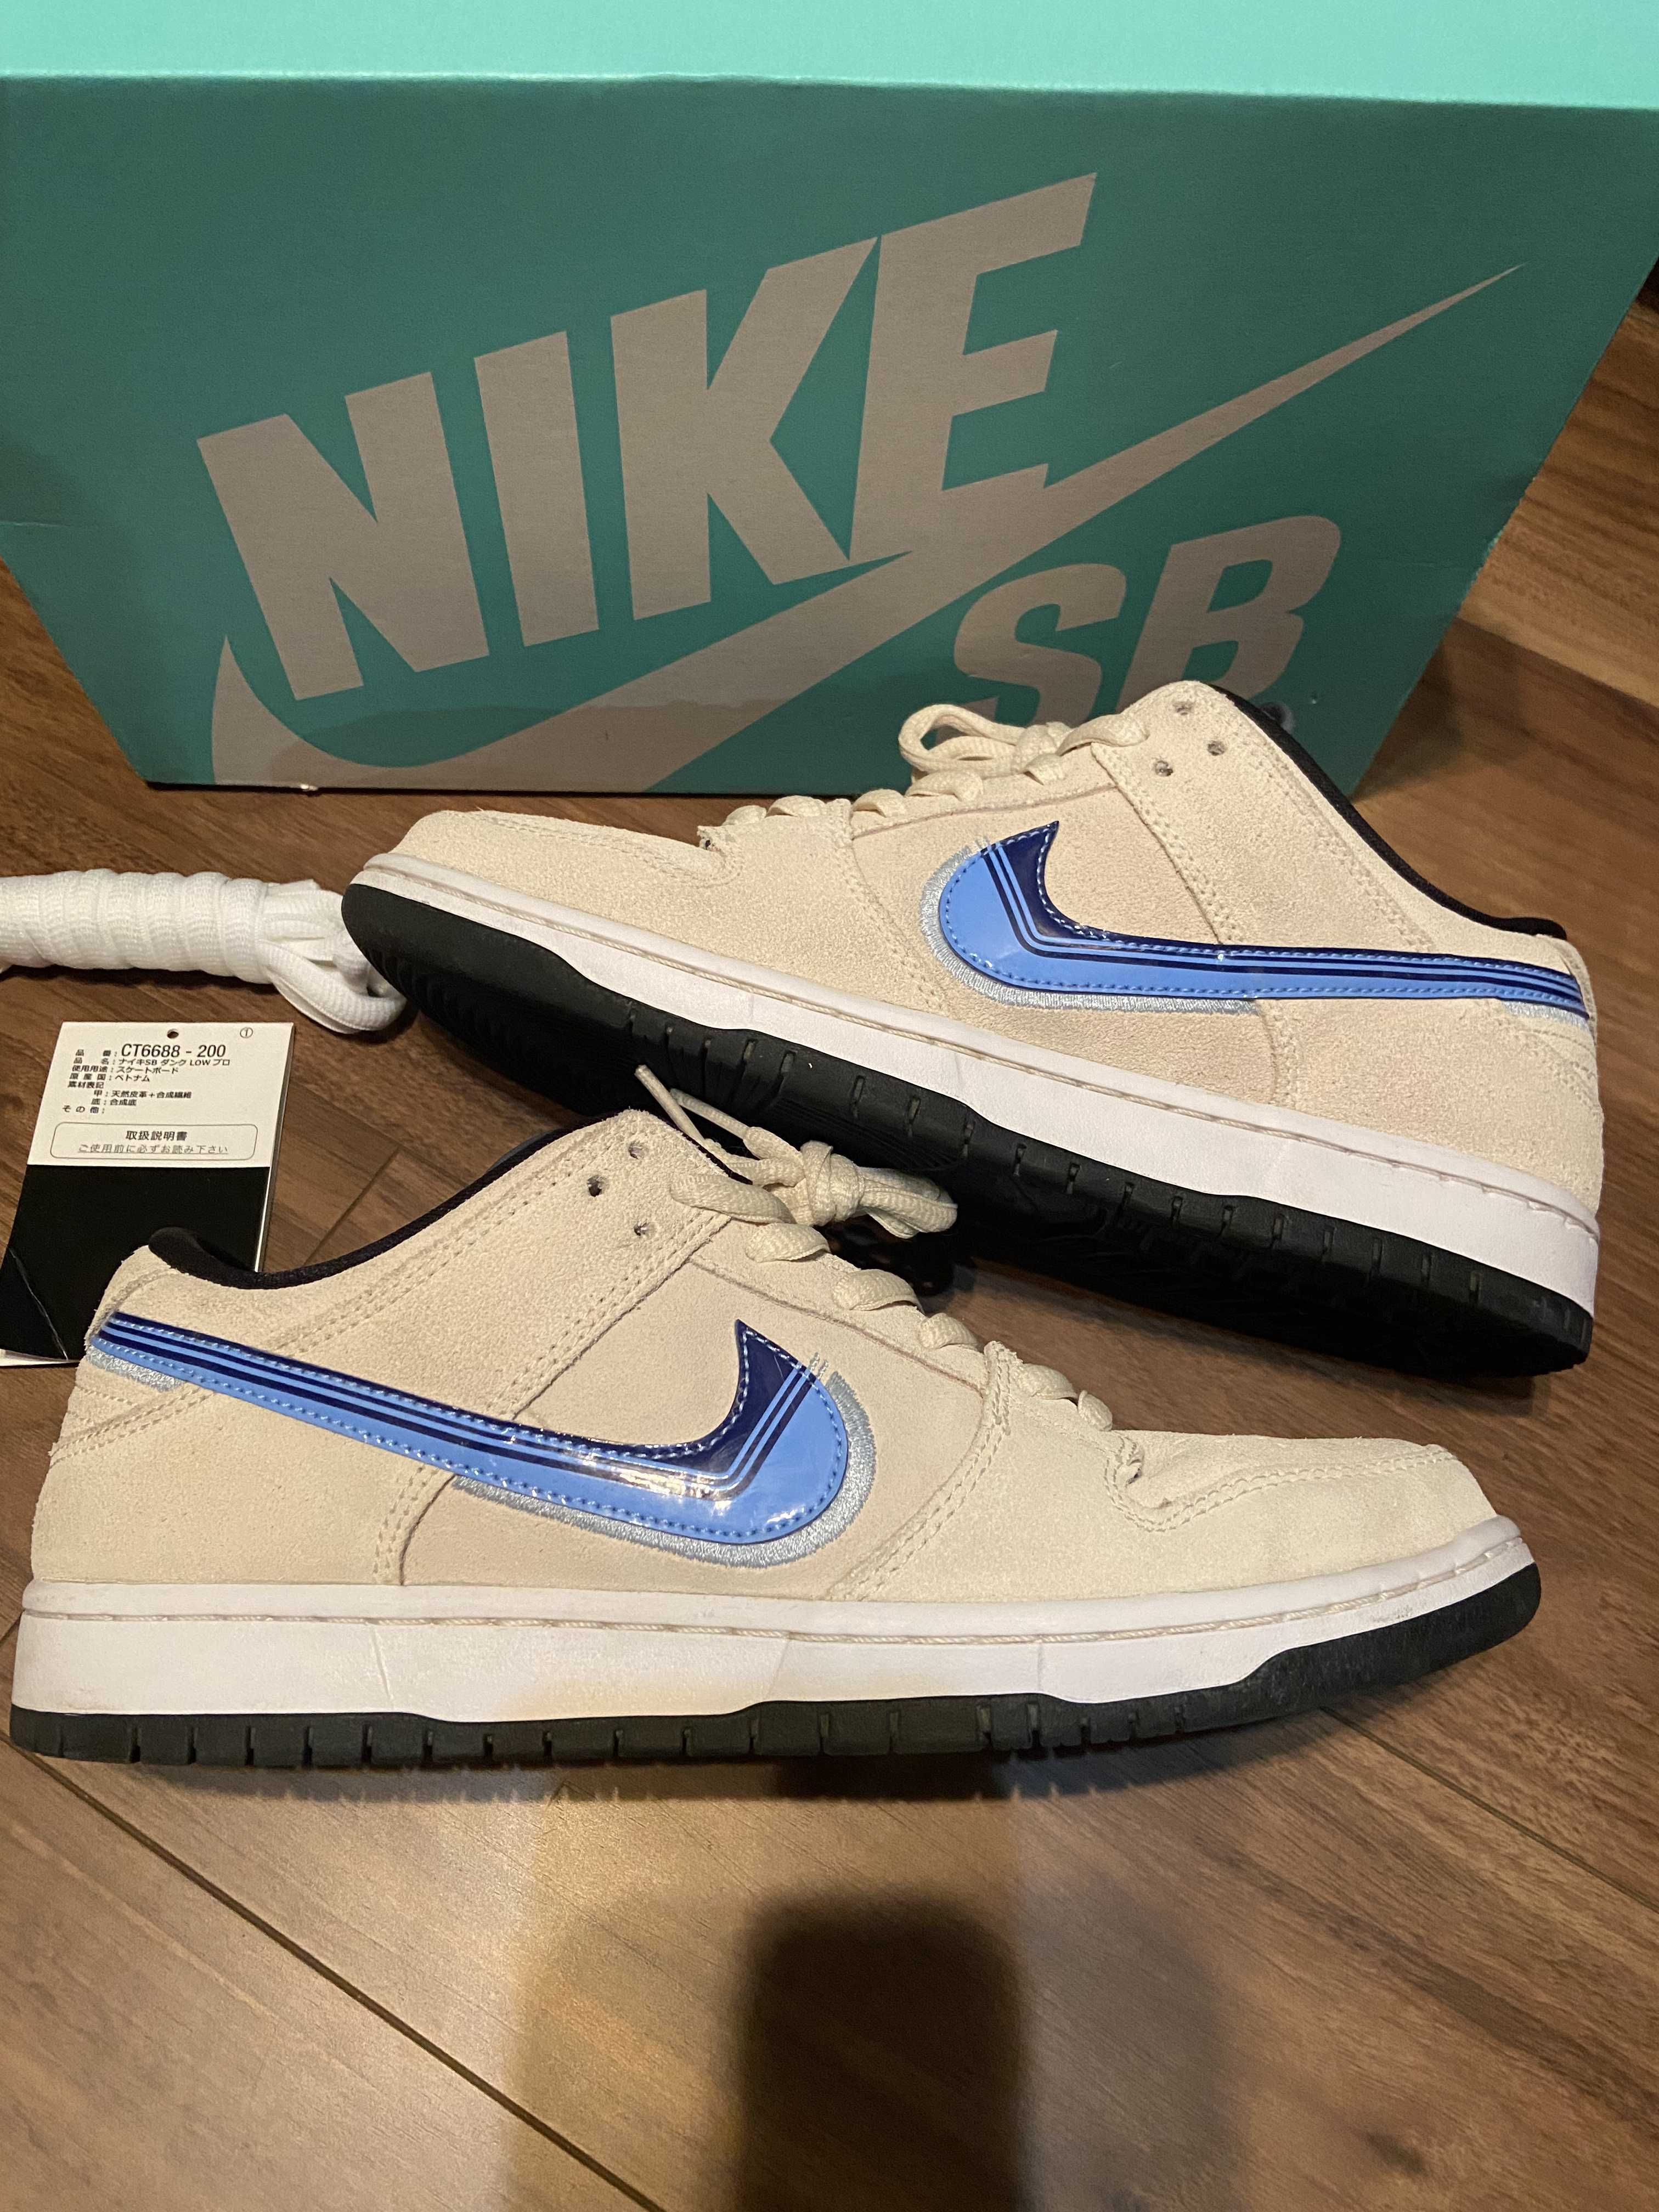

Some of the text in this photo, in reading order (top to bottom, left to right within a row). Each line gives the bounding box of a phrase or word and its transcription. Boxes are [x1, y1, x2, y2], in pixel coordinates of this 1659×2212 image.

[196, 172, 1097, 700] NIKE
[935, 515, 1341, 735] SB
[78, 1144, 229, 1155] ご使用前に必ずお読み下さい
[126, 1130, 188, 1142] 取扱説明書
